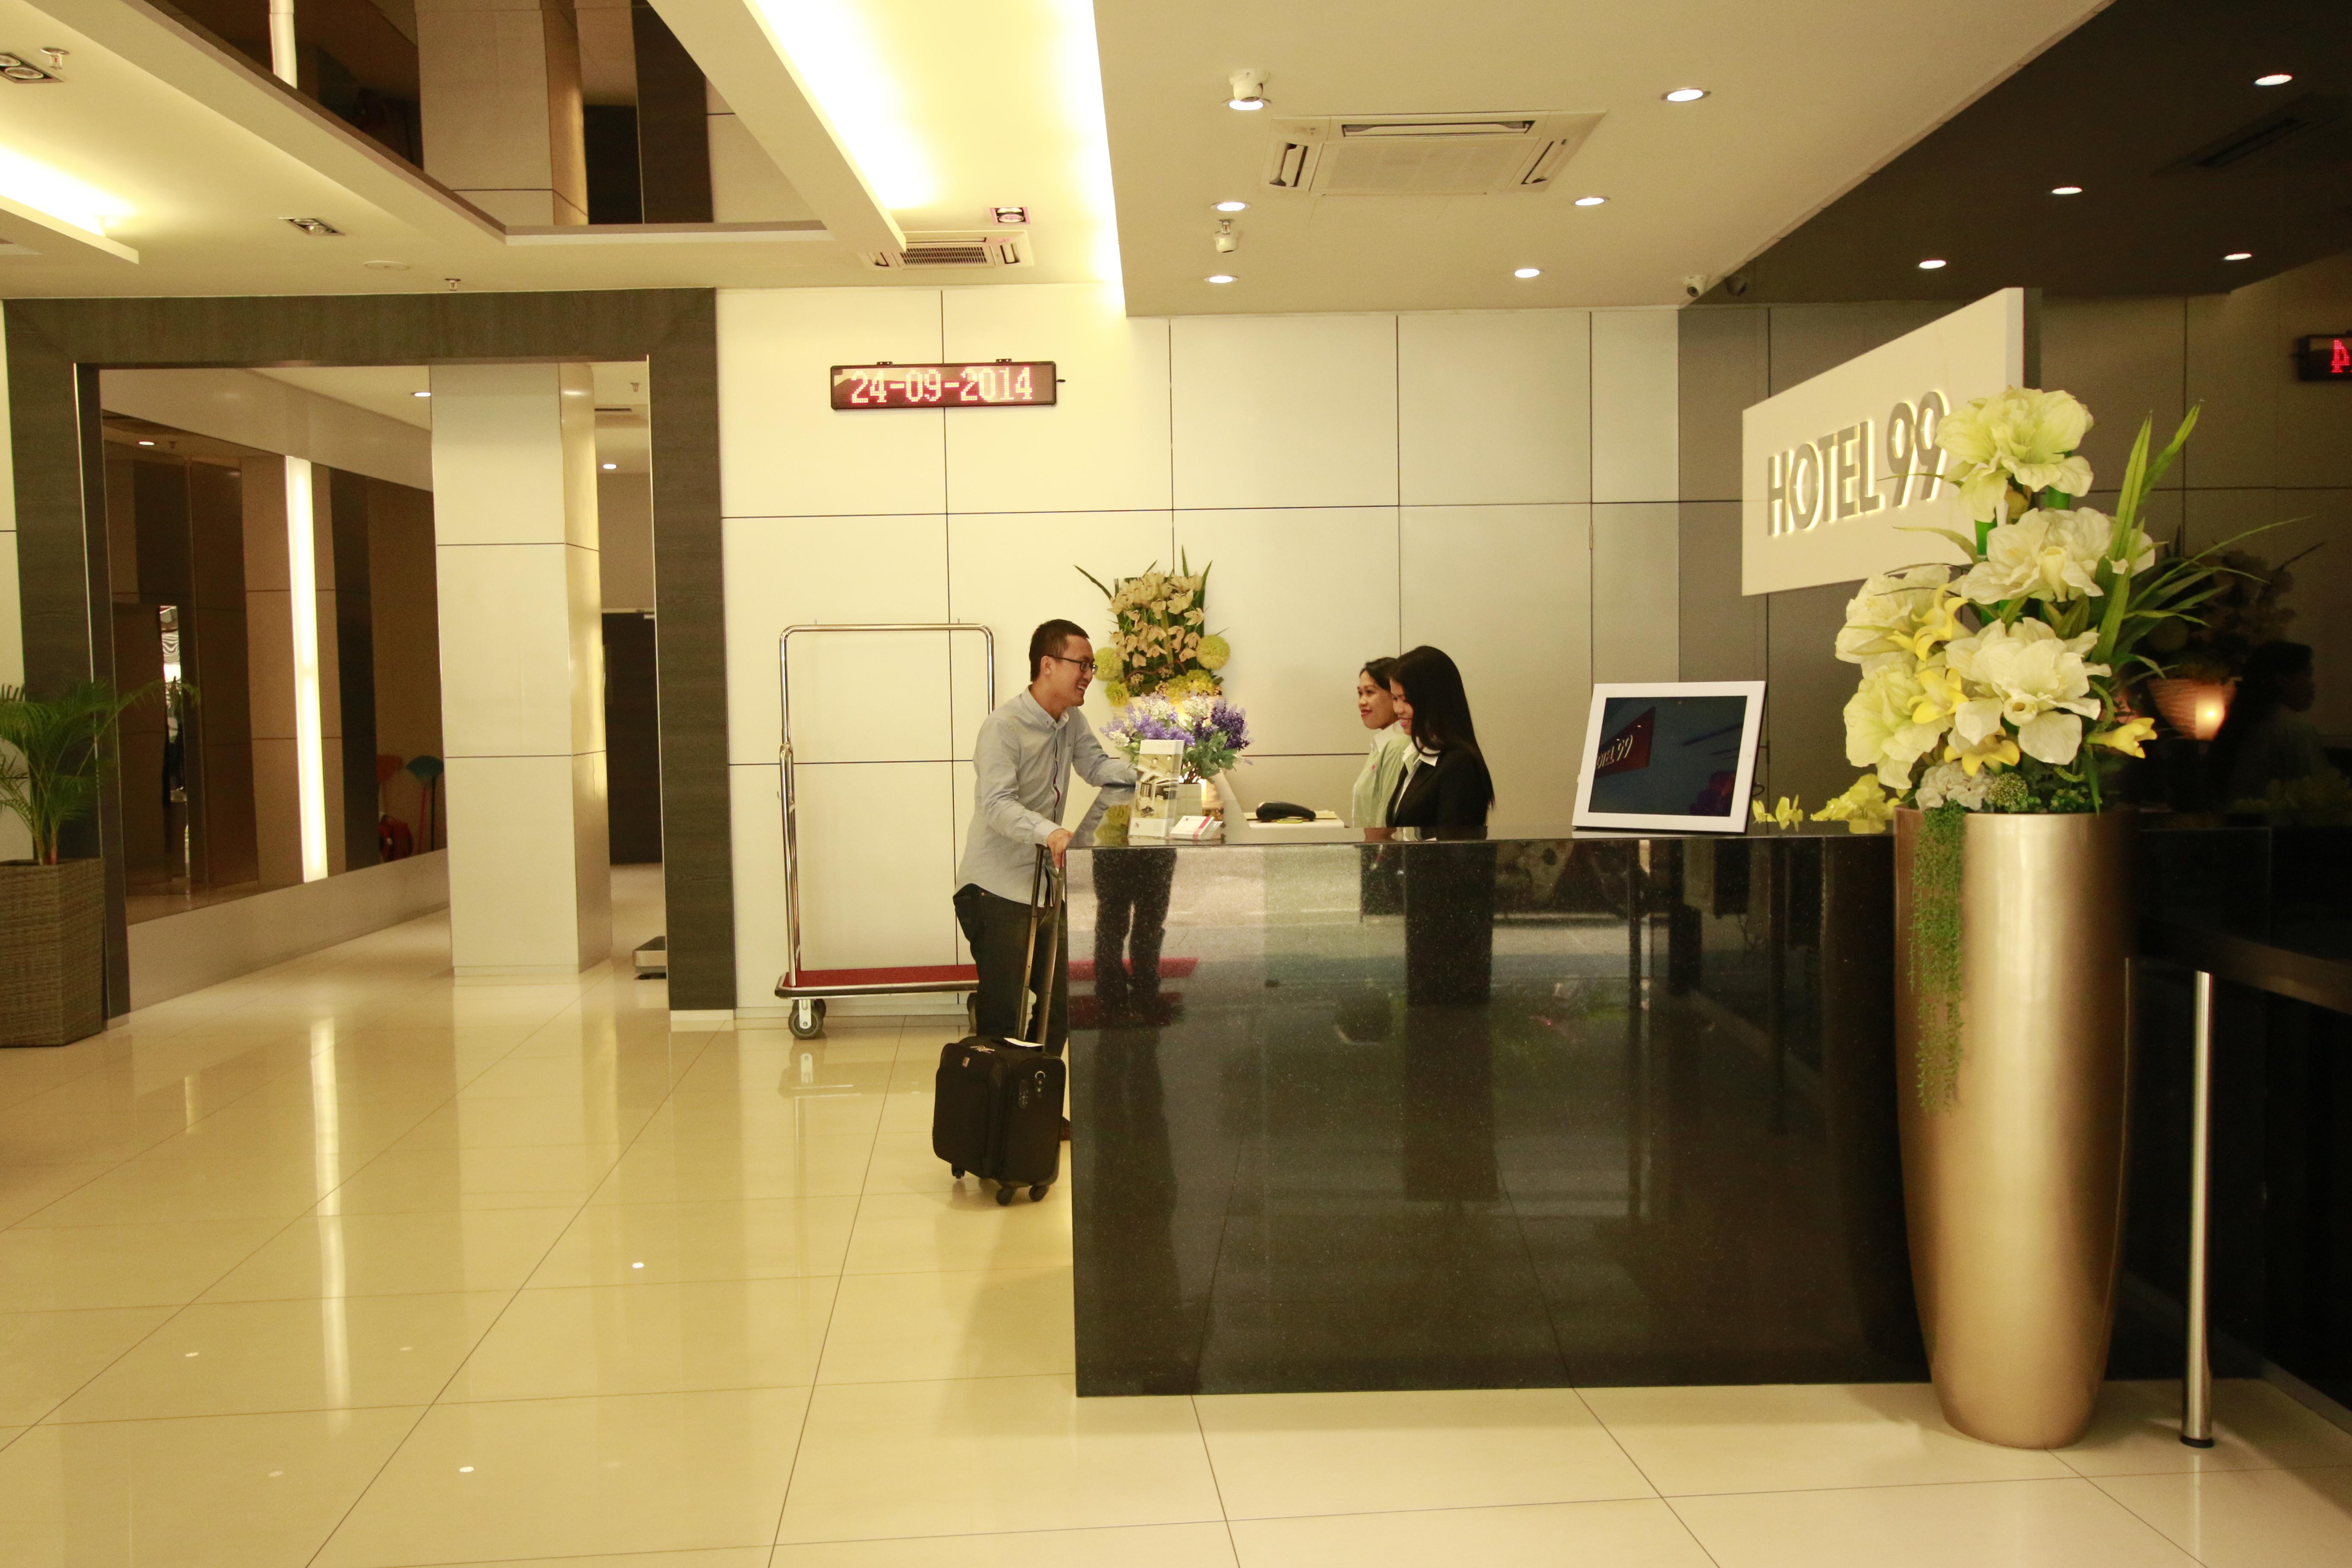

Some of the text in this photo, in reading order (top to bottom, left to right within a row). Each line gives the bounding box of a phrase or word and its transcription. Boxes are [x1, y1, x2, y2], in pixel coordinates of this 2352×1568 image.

[850, 365, 1033, 404] 24-09-2014
[1767, 390, 1950, 537] HOTEL 99
[1616, 734, 1633, 761] 99
